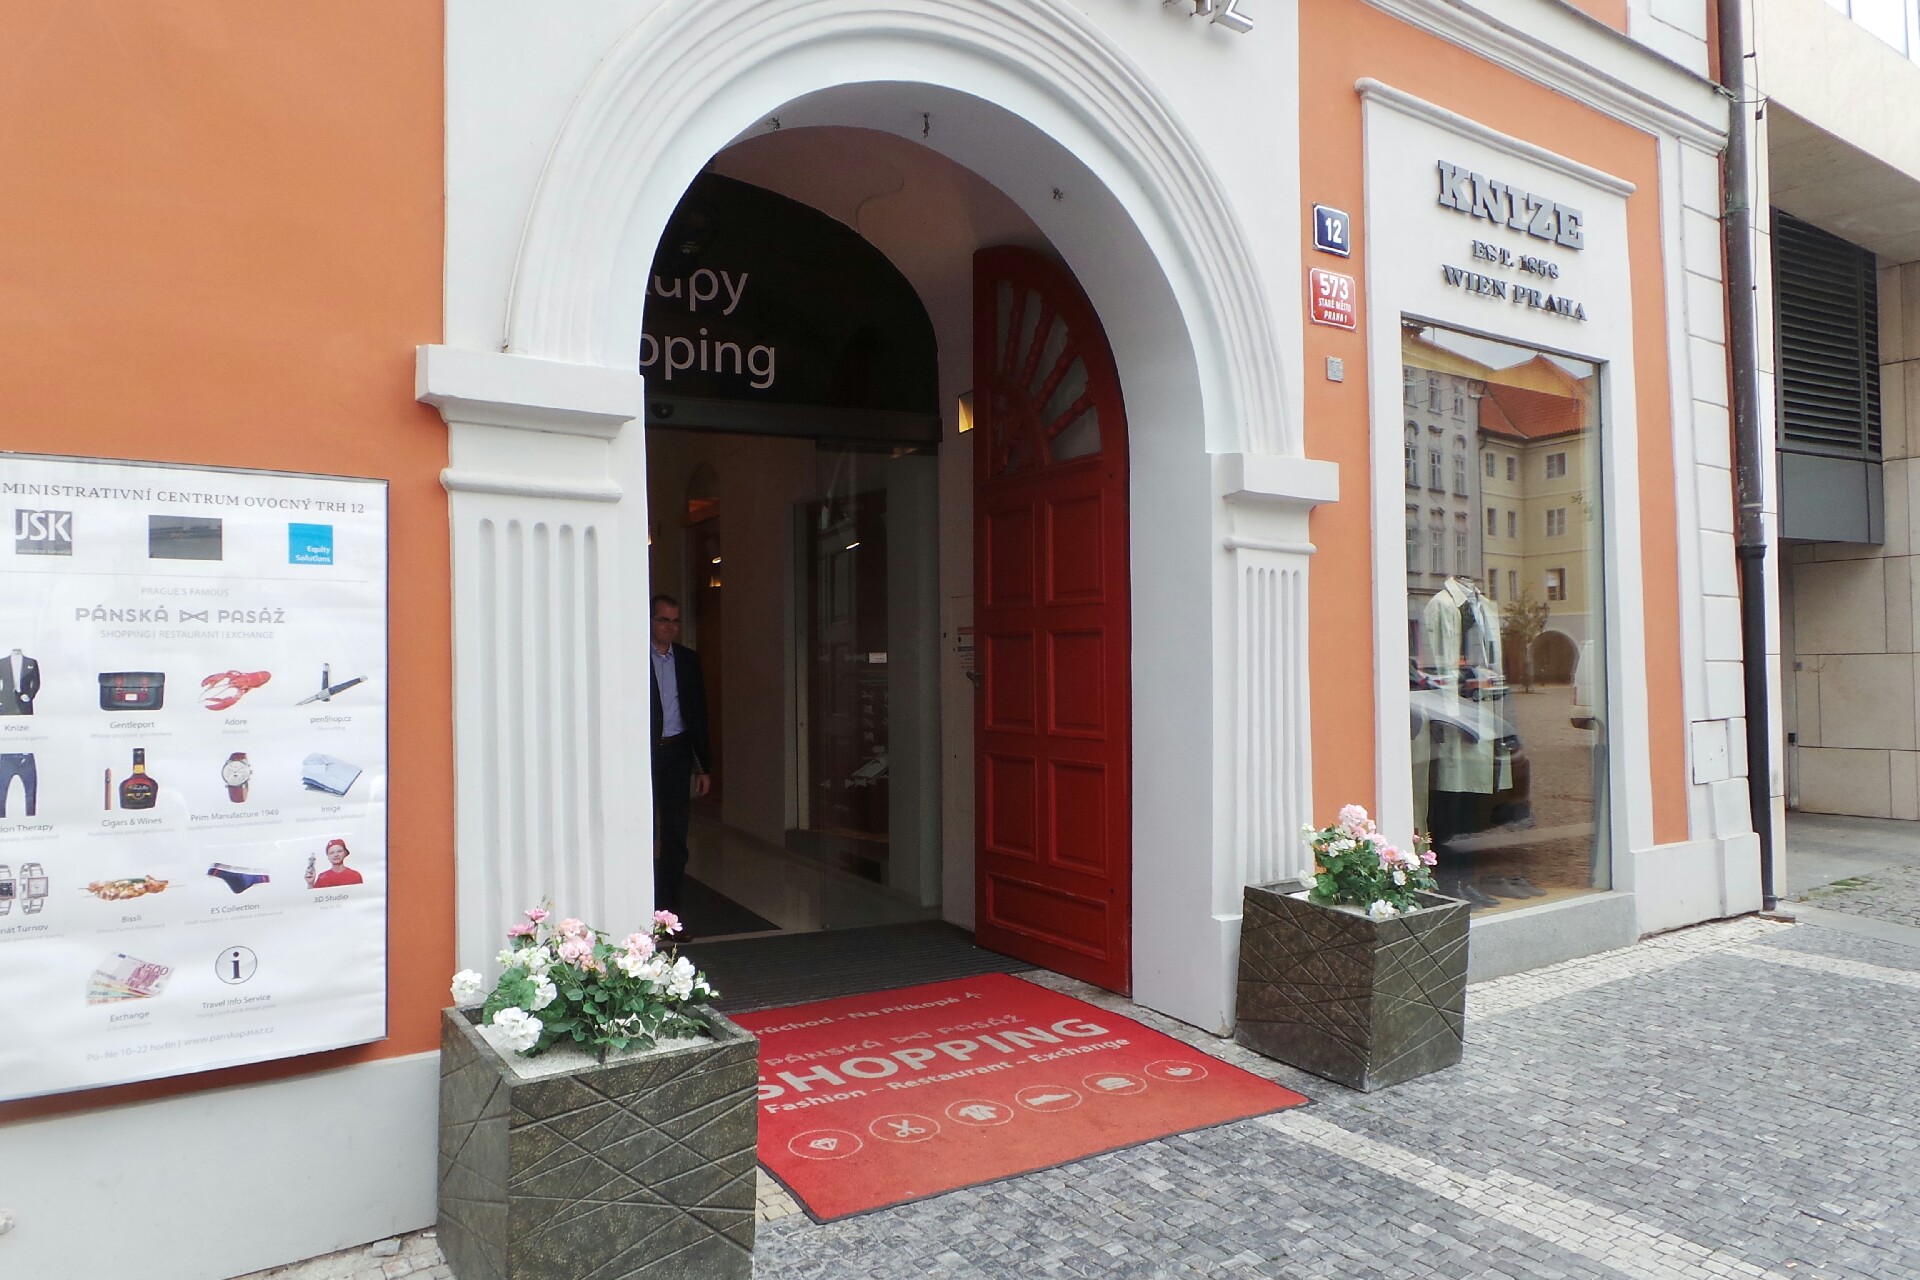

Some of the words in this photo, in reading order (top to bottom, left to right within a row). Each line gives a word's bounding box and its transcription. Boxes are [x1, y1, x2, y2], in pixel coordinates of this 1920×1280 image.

[1437, 160, 1584, 250] KNIZE
[1325, 217, 1342, 244] 12
[1472, 239, 1514, 268] EST.
[1519, 254, 1559, 279] 1858
[645, 268, 749, 316] upy
[1319, 272, 1349, 300] 573
[1442, 264, 1508, 300] WIEN
[1513, 284, 1588, 321] PRAHA
[2, 482, 151, 501] MINISTRATIVNÍ
[157, 490, 239, 506] CENTRUM
[244, 497, 311, 510] OVOCNÝ
[316, 501, 346, 513] TRH
[351, 503, 365, 514] 12
[307, 545, 331, 555] Equity
[295, 554, 331, 563] Solutions
[75, 604, 169, 623] PÁNSKÁ
[217, 607, 286, 624] PASÁŽ
[100, 629, 151, 639] SHOPPING
[159, 630, 219, 640] RESTAURANT
[226, 631, 275, 639] EXCHANGE
[109, 721, 155, 730] Gentleport
[224, 718, 248, 726] Adore
[261, 808, 279, 817] 1949
[17, 824, 54, 832] Therapy
[101, 819, 126, 829] Cigars
[137, 816, 162, 825] Wines
[325, 893, 349, 902] Studio
[221, 903, 260, 913] Collection
[18, 924, 49, 933] Turnov
[202, 999, 226, 1009] Travel
[243, 995, 271, 1004] Service
[110, 1010, 150, 1022] Exchange
[757, 1018, 1110, 1100] SHOPPING
[764, 1089, 867, 1114] Fashion
[886, 1061, 1014, 1091] Restaurant
[1029, 1037, 1131, 1064] Exchange
